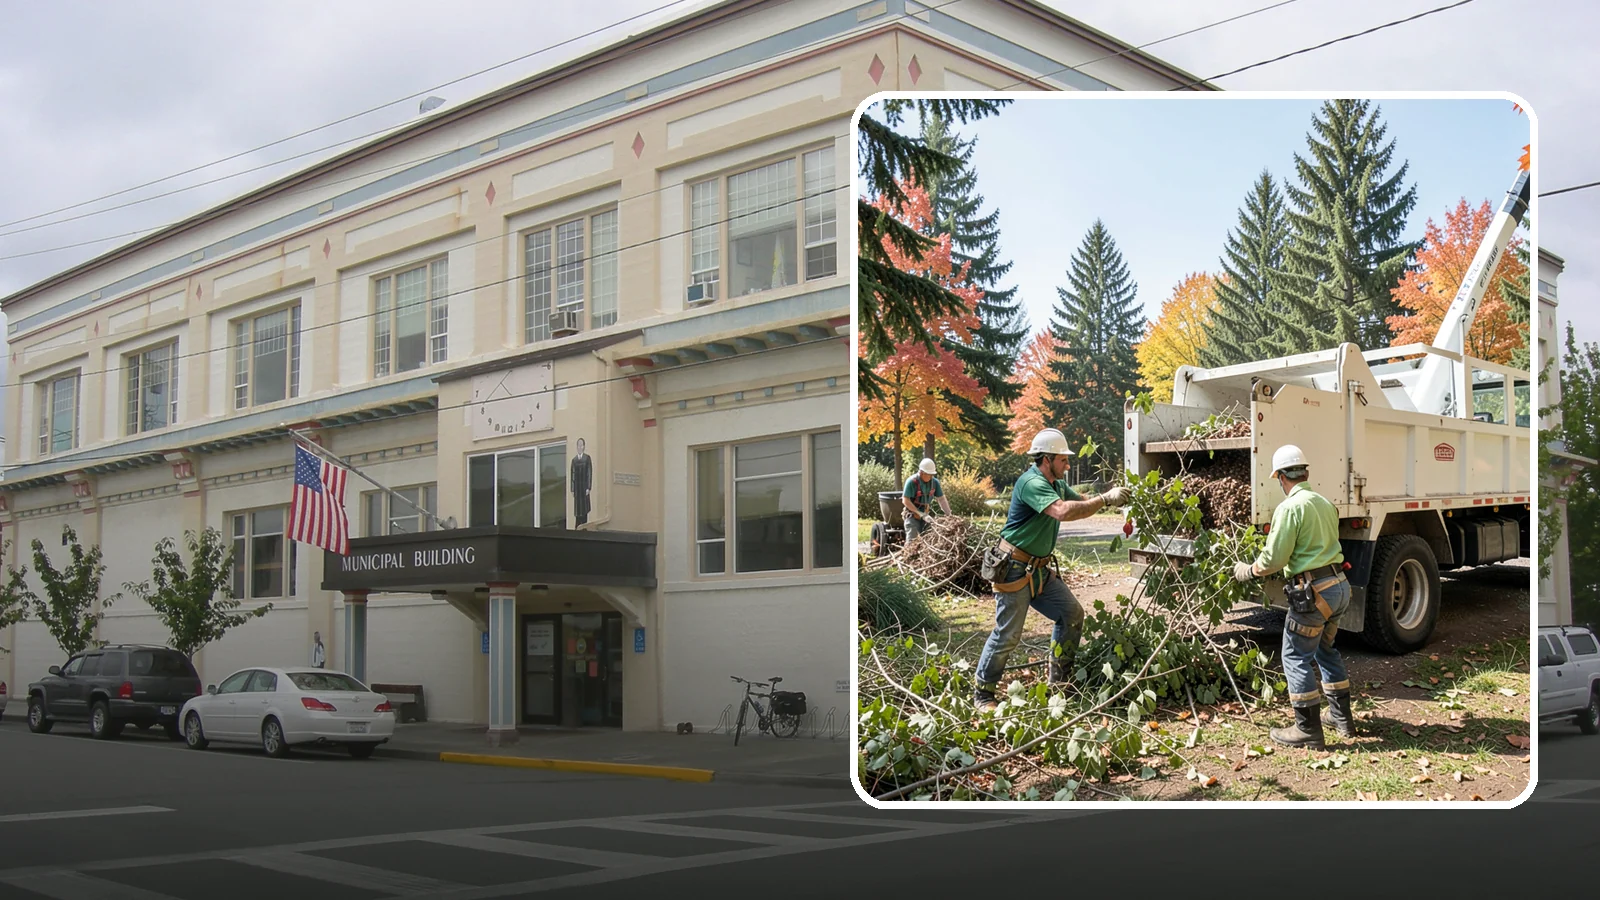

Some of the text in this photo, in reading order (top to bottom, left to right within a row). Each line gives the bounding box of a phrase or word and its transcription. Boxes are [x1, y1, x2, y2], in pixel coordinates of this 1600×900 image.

[547, 362, 552, 370] 6
[480, 406, 485, 414] 8
[536, 402, 540, 410] 4
[488, 418, 492, 426] 9
[528, 414, 532, 422] 3
[494, 424, 500, 432] 10
[521, 420, 526, 428] 2
[502, 426, 506, 434] 11
[342, 546, 475, 572] MUNICIPAL BUILDING
